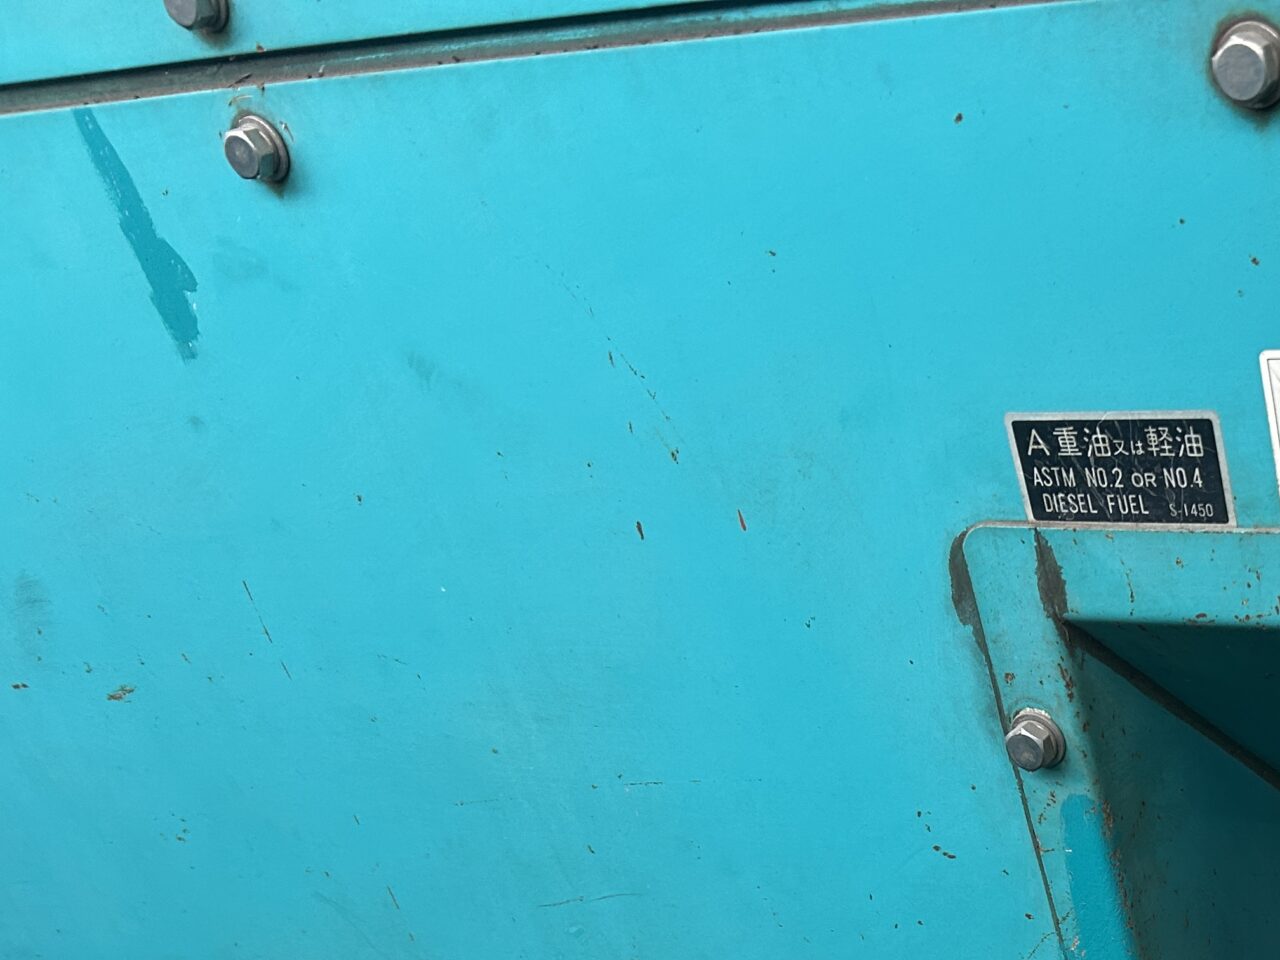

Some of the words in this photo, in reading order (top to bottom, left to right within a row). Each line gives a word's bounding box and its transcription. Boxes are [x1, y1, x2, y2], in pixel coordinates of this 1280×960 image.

[1033, 467, 1076, 487] ASTM
[1085, 468, 1124, 488] NO.2
[1131, 472, 1157, 488] OR
[1163, 468, 1202, 488] NO.4
[1043, 493, 1097, 514] DIESEL
[1107, 494, 1149, 514] FUEL
[1169, 503, 1213, 518] S-1450
